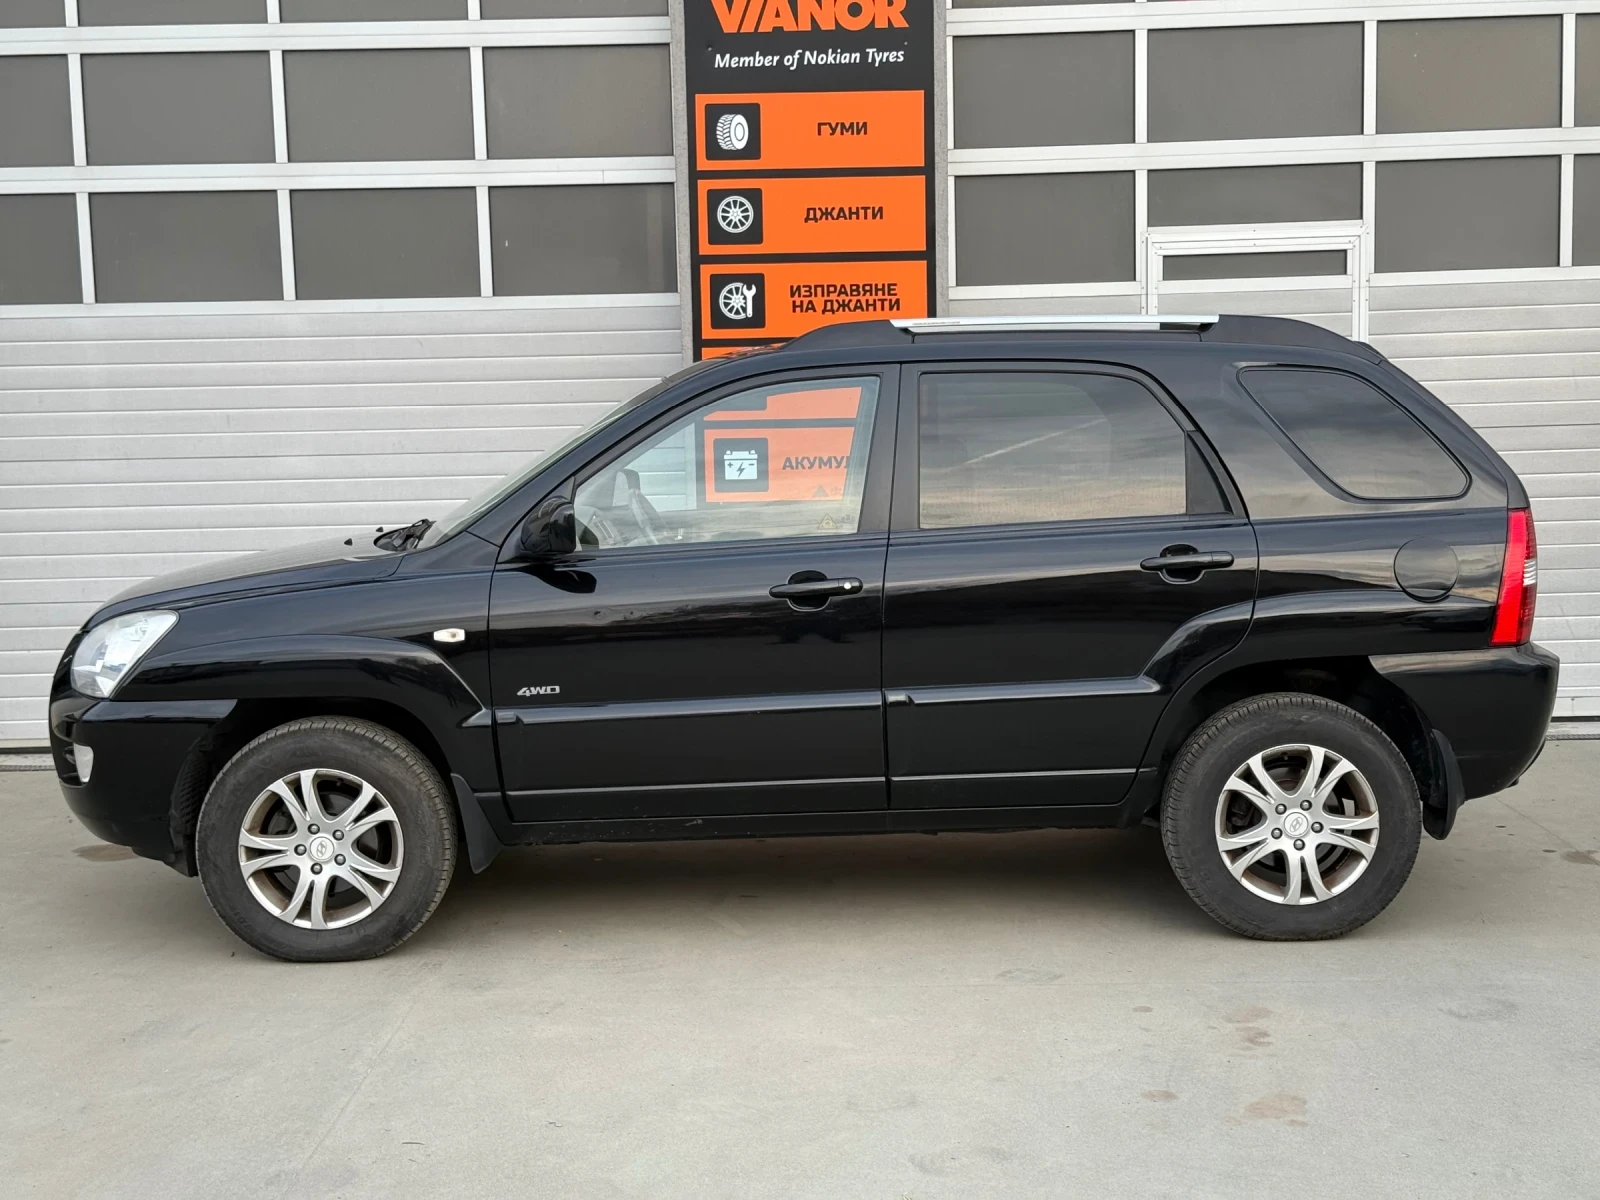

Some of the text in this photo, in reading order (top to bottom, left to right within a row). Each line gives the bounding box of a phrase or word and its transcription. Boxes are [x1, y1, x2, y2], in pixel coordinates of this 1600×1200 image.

[711, 0, 909, 33] VIANOR
[714, 48, 905, 70] Member of Nokian Tyres
[817, 121, 868, 136] ГУМИ
[804, 206, 884, 223] ДЖАНТИ
[790, 283, 898, 298] ИЗПРАВЯНЕ
[791, 297, 901, 314] НА ДЖАНТИ
[516, 685, 560, 696] 4WD
